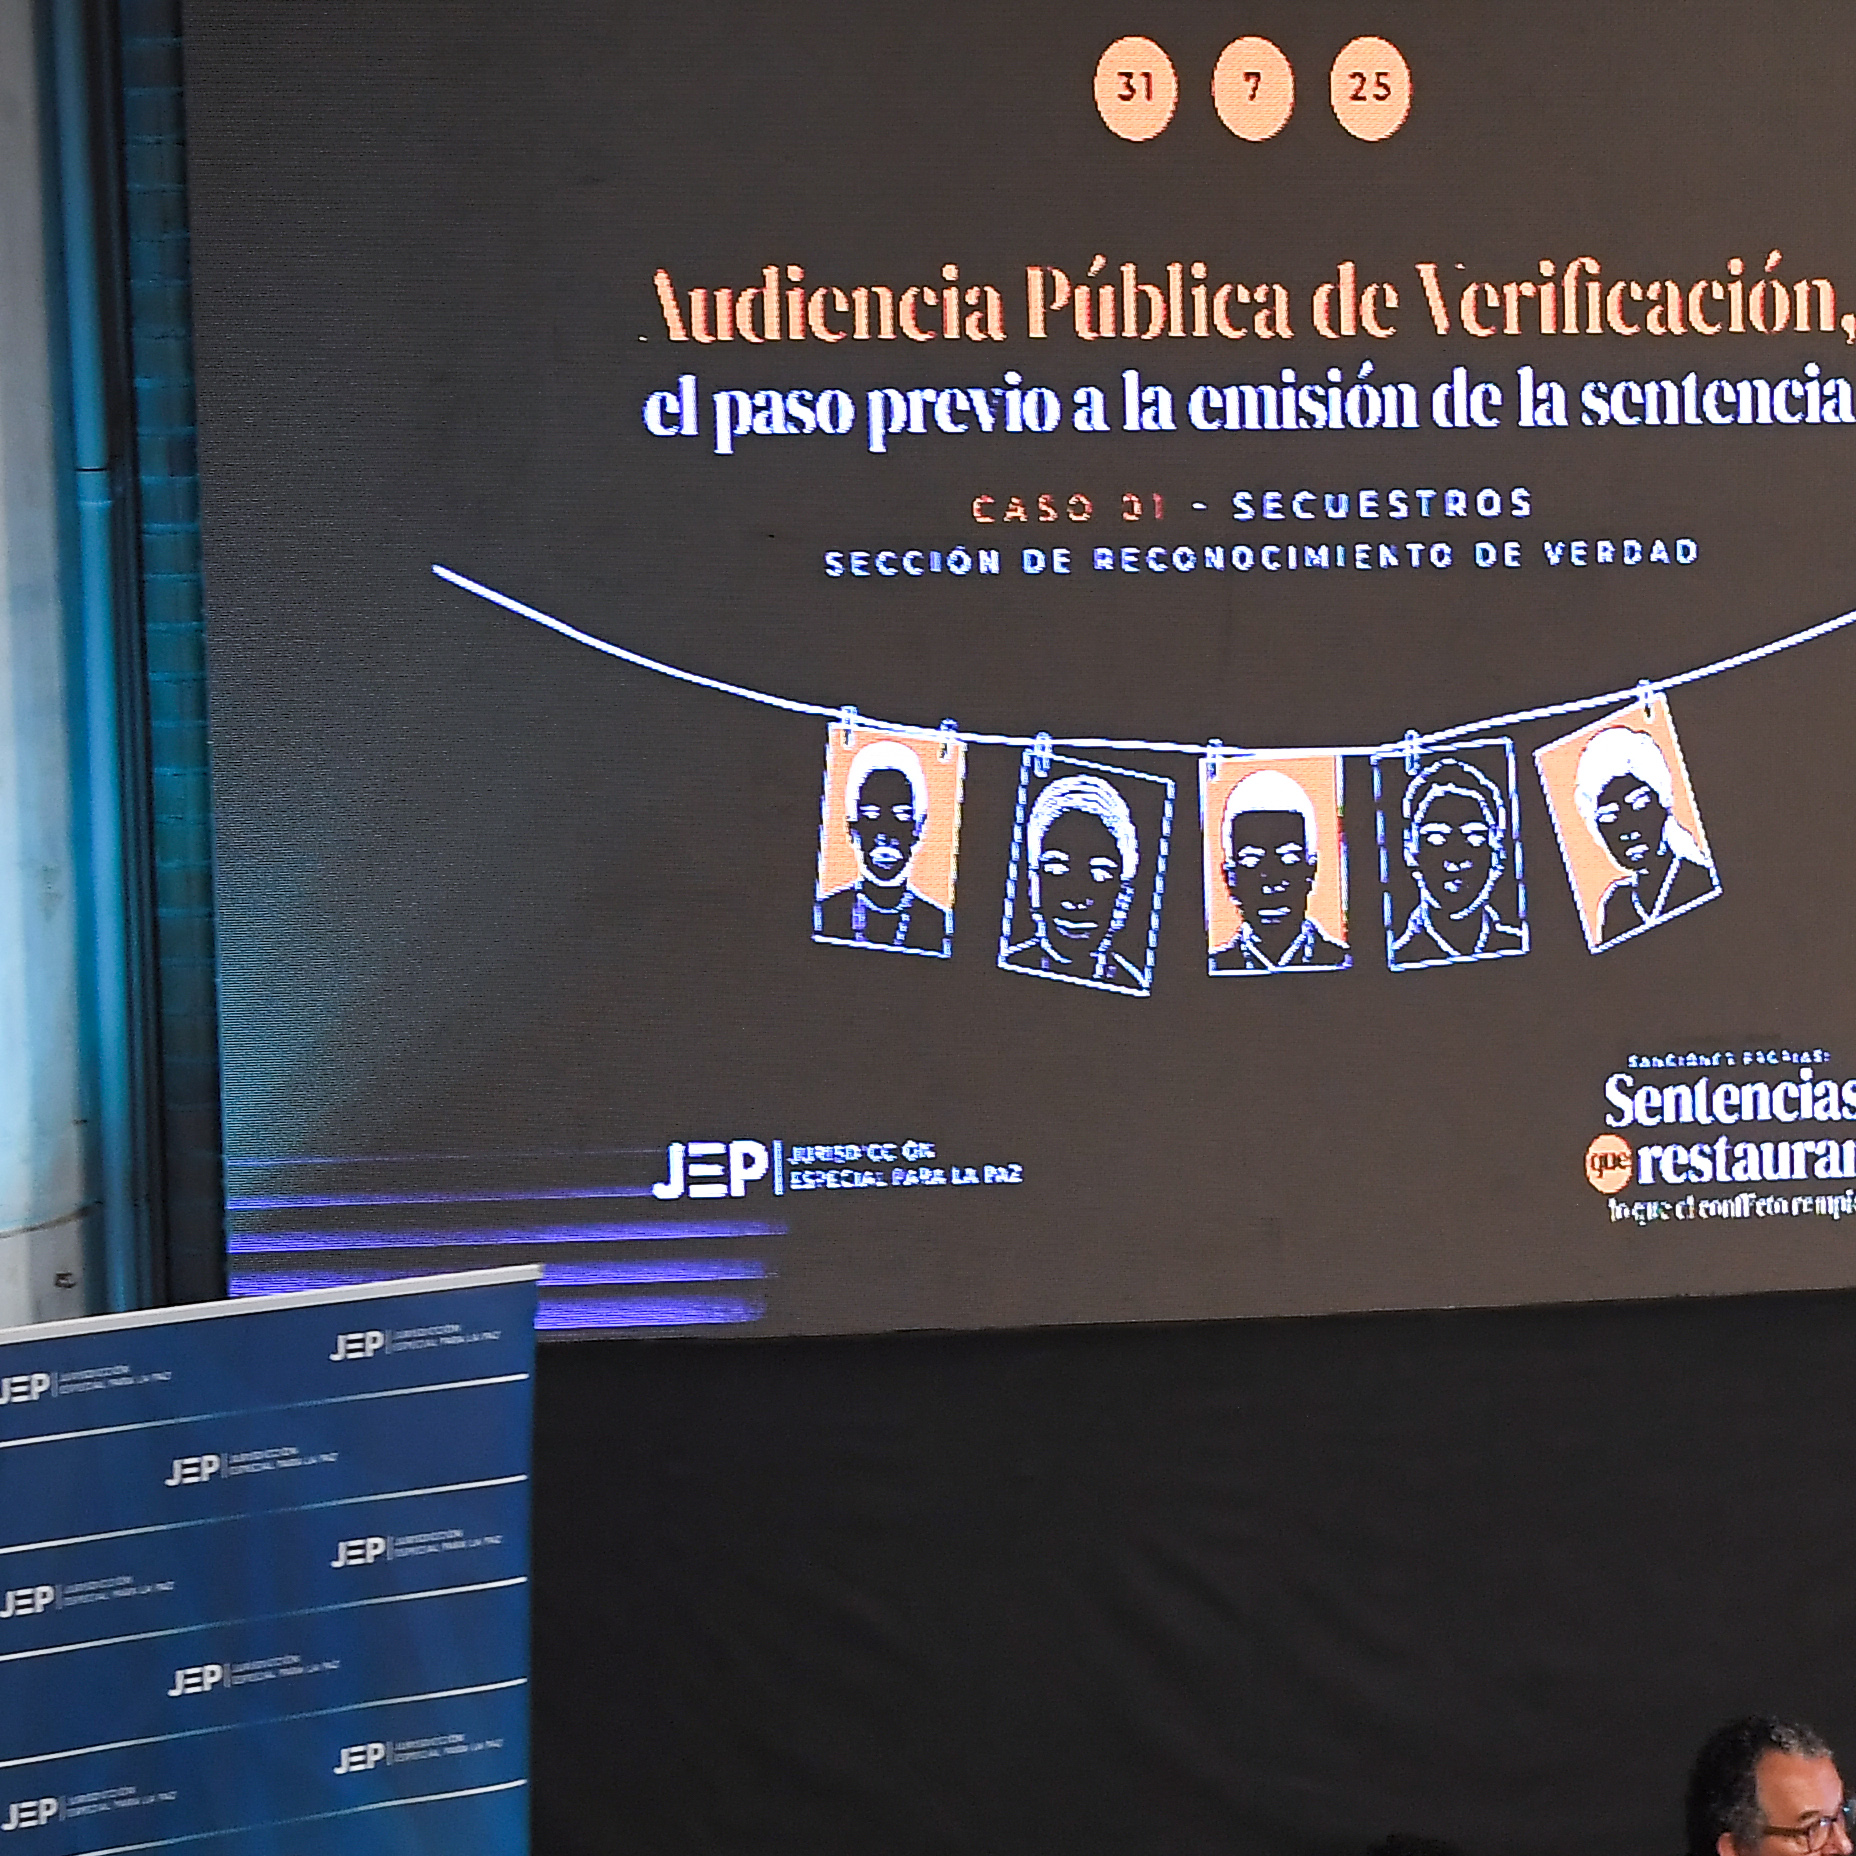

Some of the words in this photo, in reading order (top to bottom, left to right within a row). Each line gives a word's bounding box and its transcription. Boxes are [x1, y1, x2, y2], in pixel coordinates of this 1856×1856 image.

[1116, 71, 1153, 102] 31
[1243, 71, 1262, 102] 7
[1348, 71, 1392, 102] 25
[639, 265, 1006, 343] Audiencia
[1027, 255, 1294, 340] Pública
[1313, 262, 1398, 338] de
[642, 375, 698, 436] el
[712, 390, 855, 454] paso
[867, 371, 1061, 452] previo
[1072, 387, 1110, 431] a
[1122, 370, 1177, 430] la
[1188, 360, 1420, 430] emisión
[1432, 367, 1502, 427] de
[1517, 366, 1568, 426] la
[1582, 363, 1856, 425] sentencia
[973, 494, 1092, 522] CASO
[1233, 488, 1530, 521] SECUESTROS
[825, 546, 999, 576] SECCIÓN
[1022, 549, 1070, 573] DE
[1094, 543, 1452, 572] RECONOCIMIENTO
[1476, 542, 1520, 567] DE
[1544, 539, 1697, 565] VERDAD
[652, 1140, 769, 1199] JEP
[1590, 1152, 1631, 1179] que
[329, 1331, 385, 1361] JEP
[0, 1373, 51, 1405] JEP
[164, 1454, 221, 1487] JEP
[330, 1537, 387, 1568] JEP
[0, 1585, 55, 1618] JEP
[167, 1664, 223, 1697] JEP
[333, 1743, 386, 1775] JEP
[1, 1798, 59, 1831] JEP
